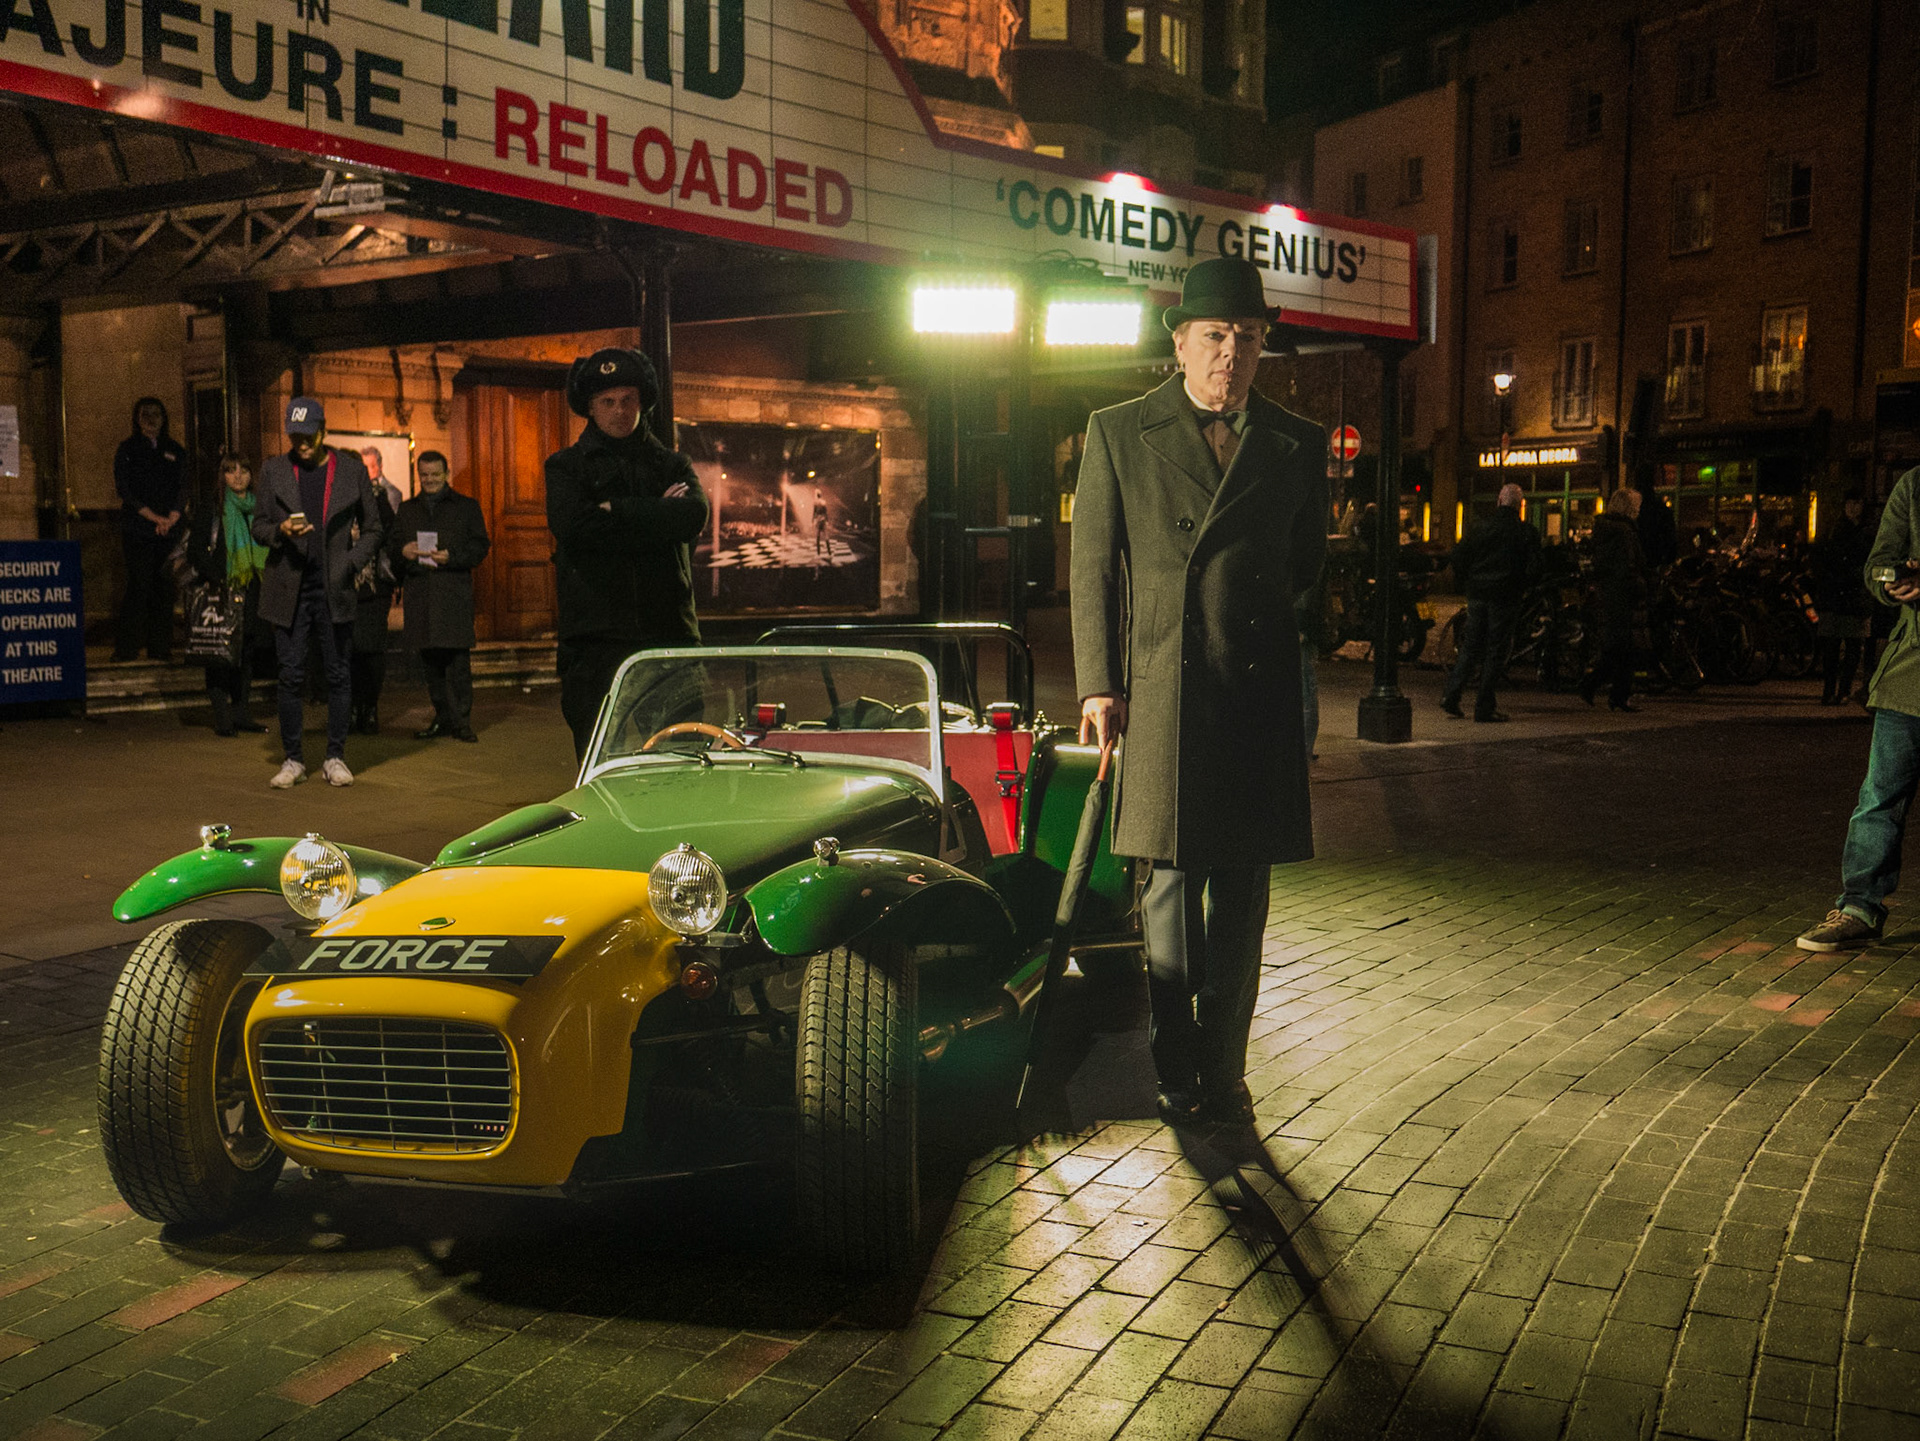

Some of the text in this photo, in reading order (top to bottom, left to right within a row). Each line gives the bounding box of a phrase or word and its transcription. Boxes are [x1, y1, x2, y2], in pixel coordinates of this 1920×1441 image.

[495, 86, 853, 229] RELOADED
[1128, 259, 1165, 281] NEW
[1479, 452, 1495, 468] LA
[1538, 447, 1578, 465] NEGRA
[0, 561, 61, 578] SECURITY
[44, 587, 71, 603] ARE
[2, 613, 77, 631] OPERATION
[5, 640, 58, 658] AT THIS
[2, 666, 62, 684] THEATRE
[298, 938, 508, 971] FORCE
